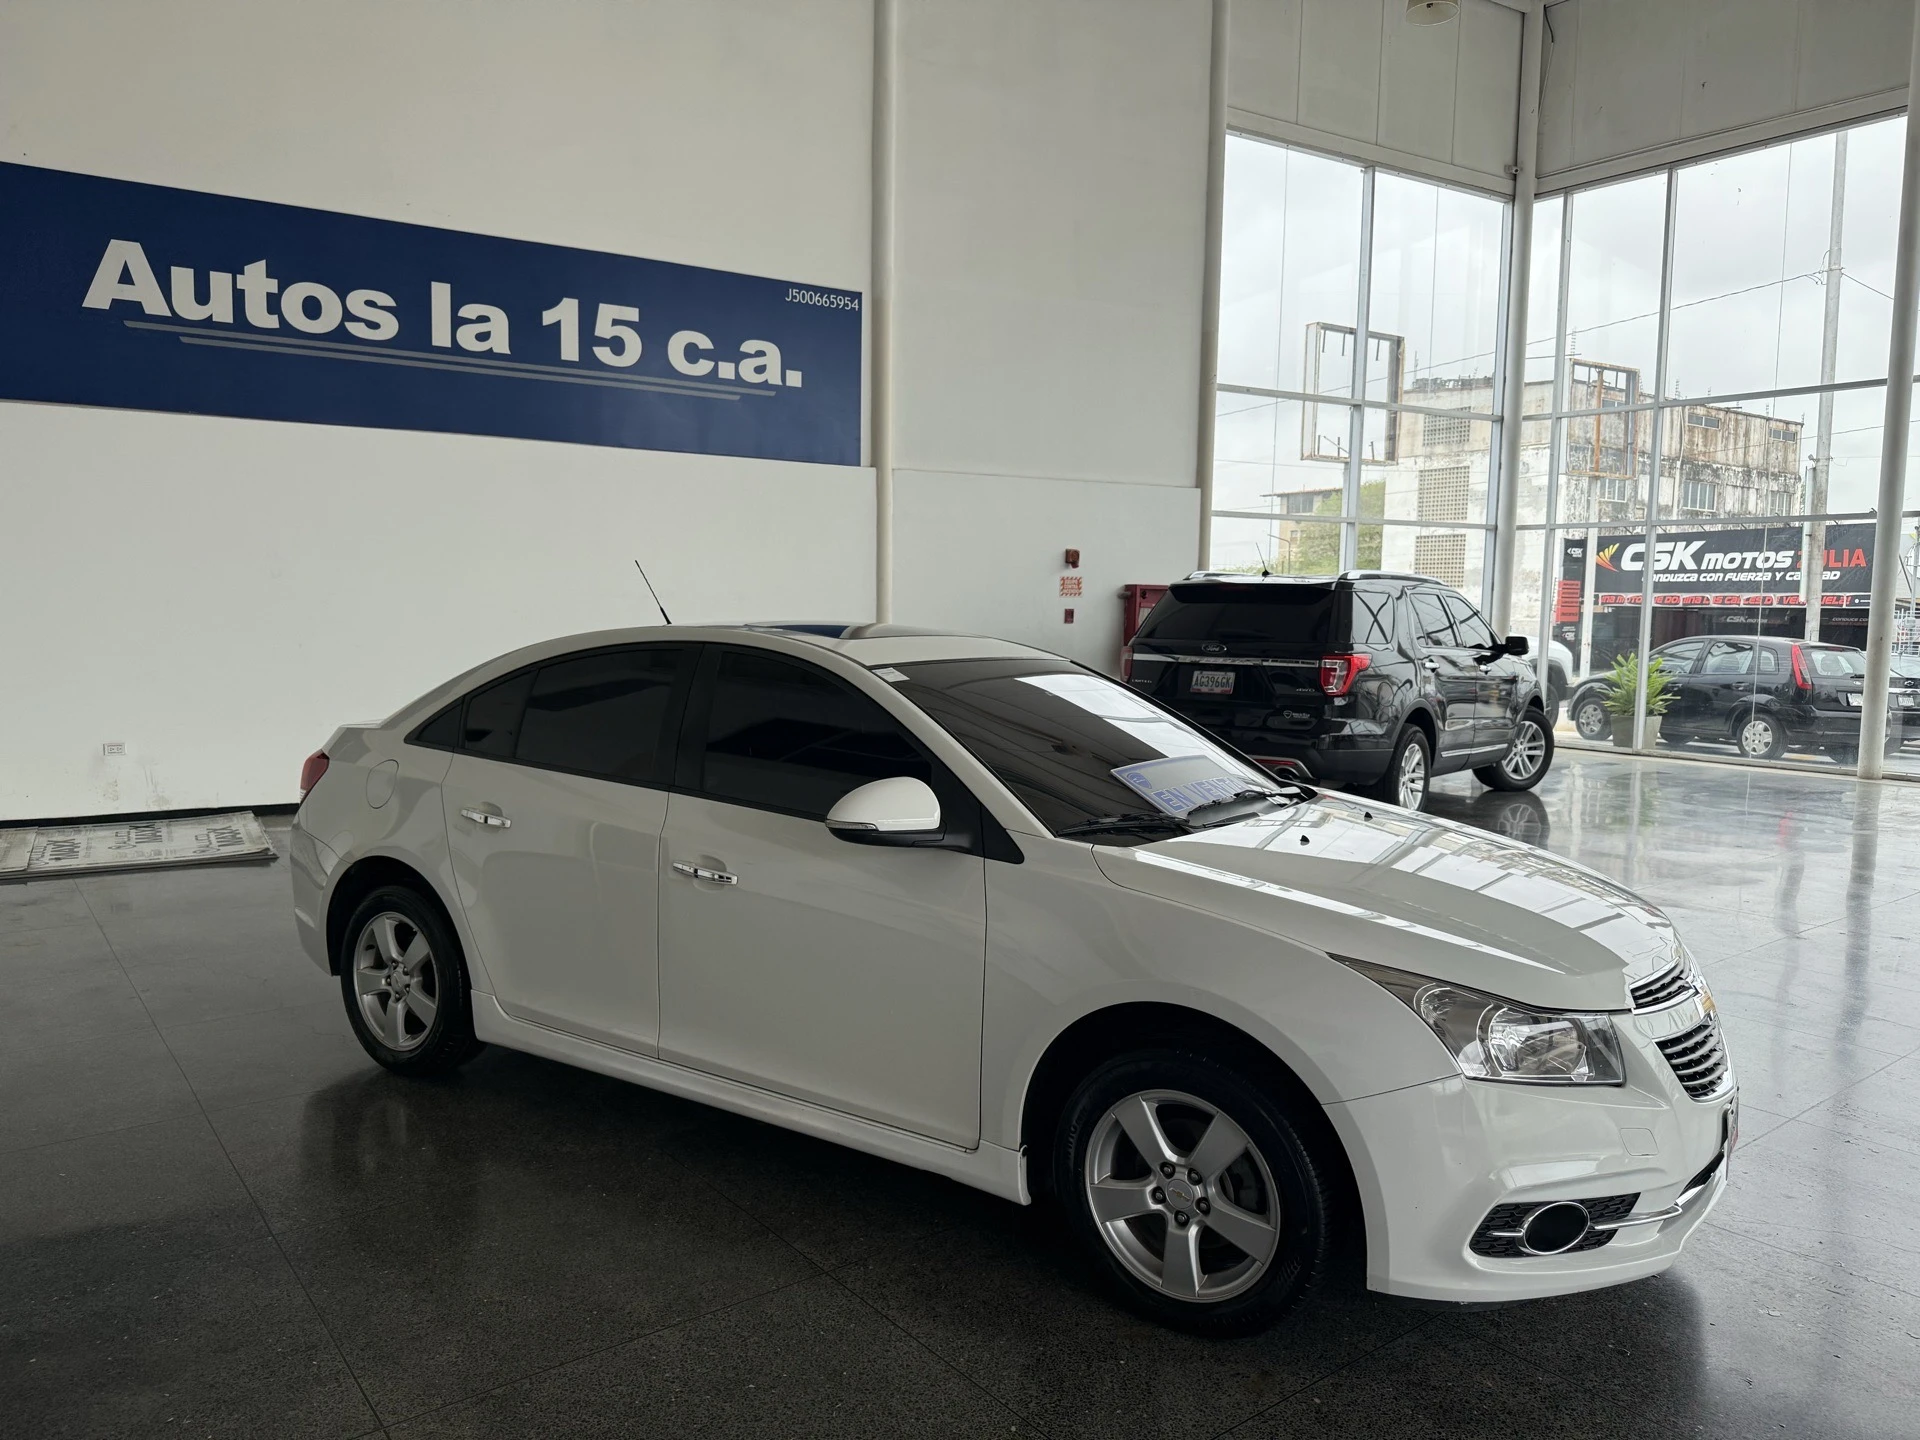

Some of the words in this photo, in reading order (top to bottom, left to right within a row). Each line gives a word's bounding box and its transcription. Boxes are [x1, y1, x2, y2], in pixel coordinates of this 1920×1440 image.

[785, 288, 859, 311] J500665954
[82, 239, 399, 341] Autos
[430, 282, 511, 355] la
[541, 297, 643, 367] 15
[666, 328, 803, 388] c.a.
[1620, 540, 1706, 571] CSK
[1701, 550, 1795, 569] MOTOS
[1796, 548, 1867, 568] LIA
[1642, 572, 1698, 582] NDUZCA
[1699, 572, 1723, 582] CON
[1724, 572, 1772, 581] FUERZA
[1775, 571, 1785, 581] Y
[1785, 570, 1840, 580] CAAD
[1151, 787, 1197, 812] EN
